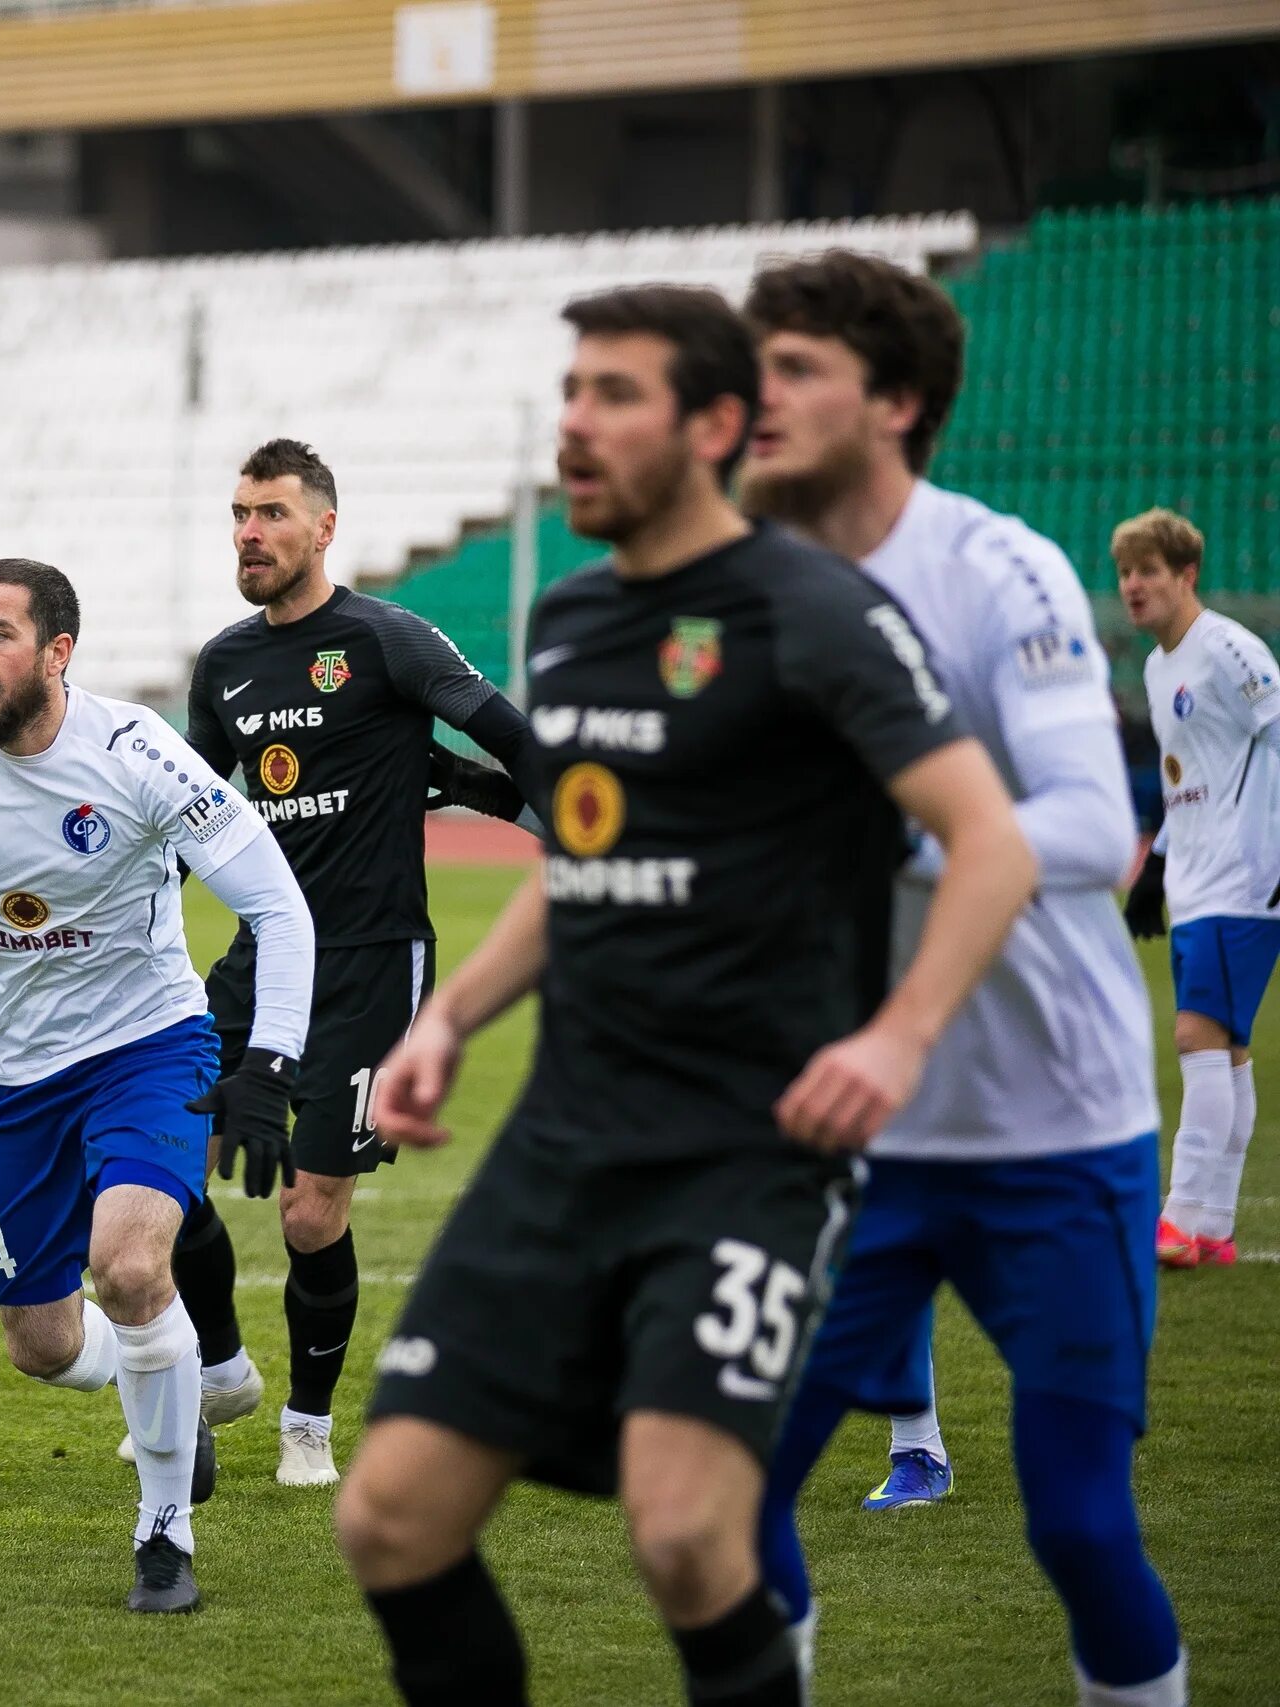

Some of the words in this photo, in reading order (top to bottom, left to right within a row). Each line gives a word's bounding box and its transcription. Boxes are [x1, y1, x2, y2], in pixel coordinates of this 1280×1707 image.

[268, 706, 324, 731] МКБ
[270, 1055, 284, 1073] 4
[692, 1238, 808, 1381] 35
